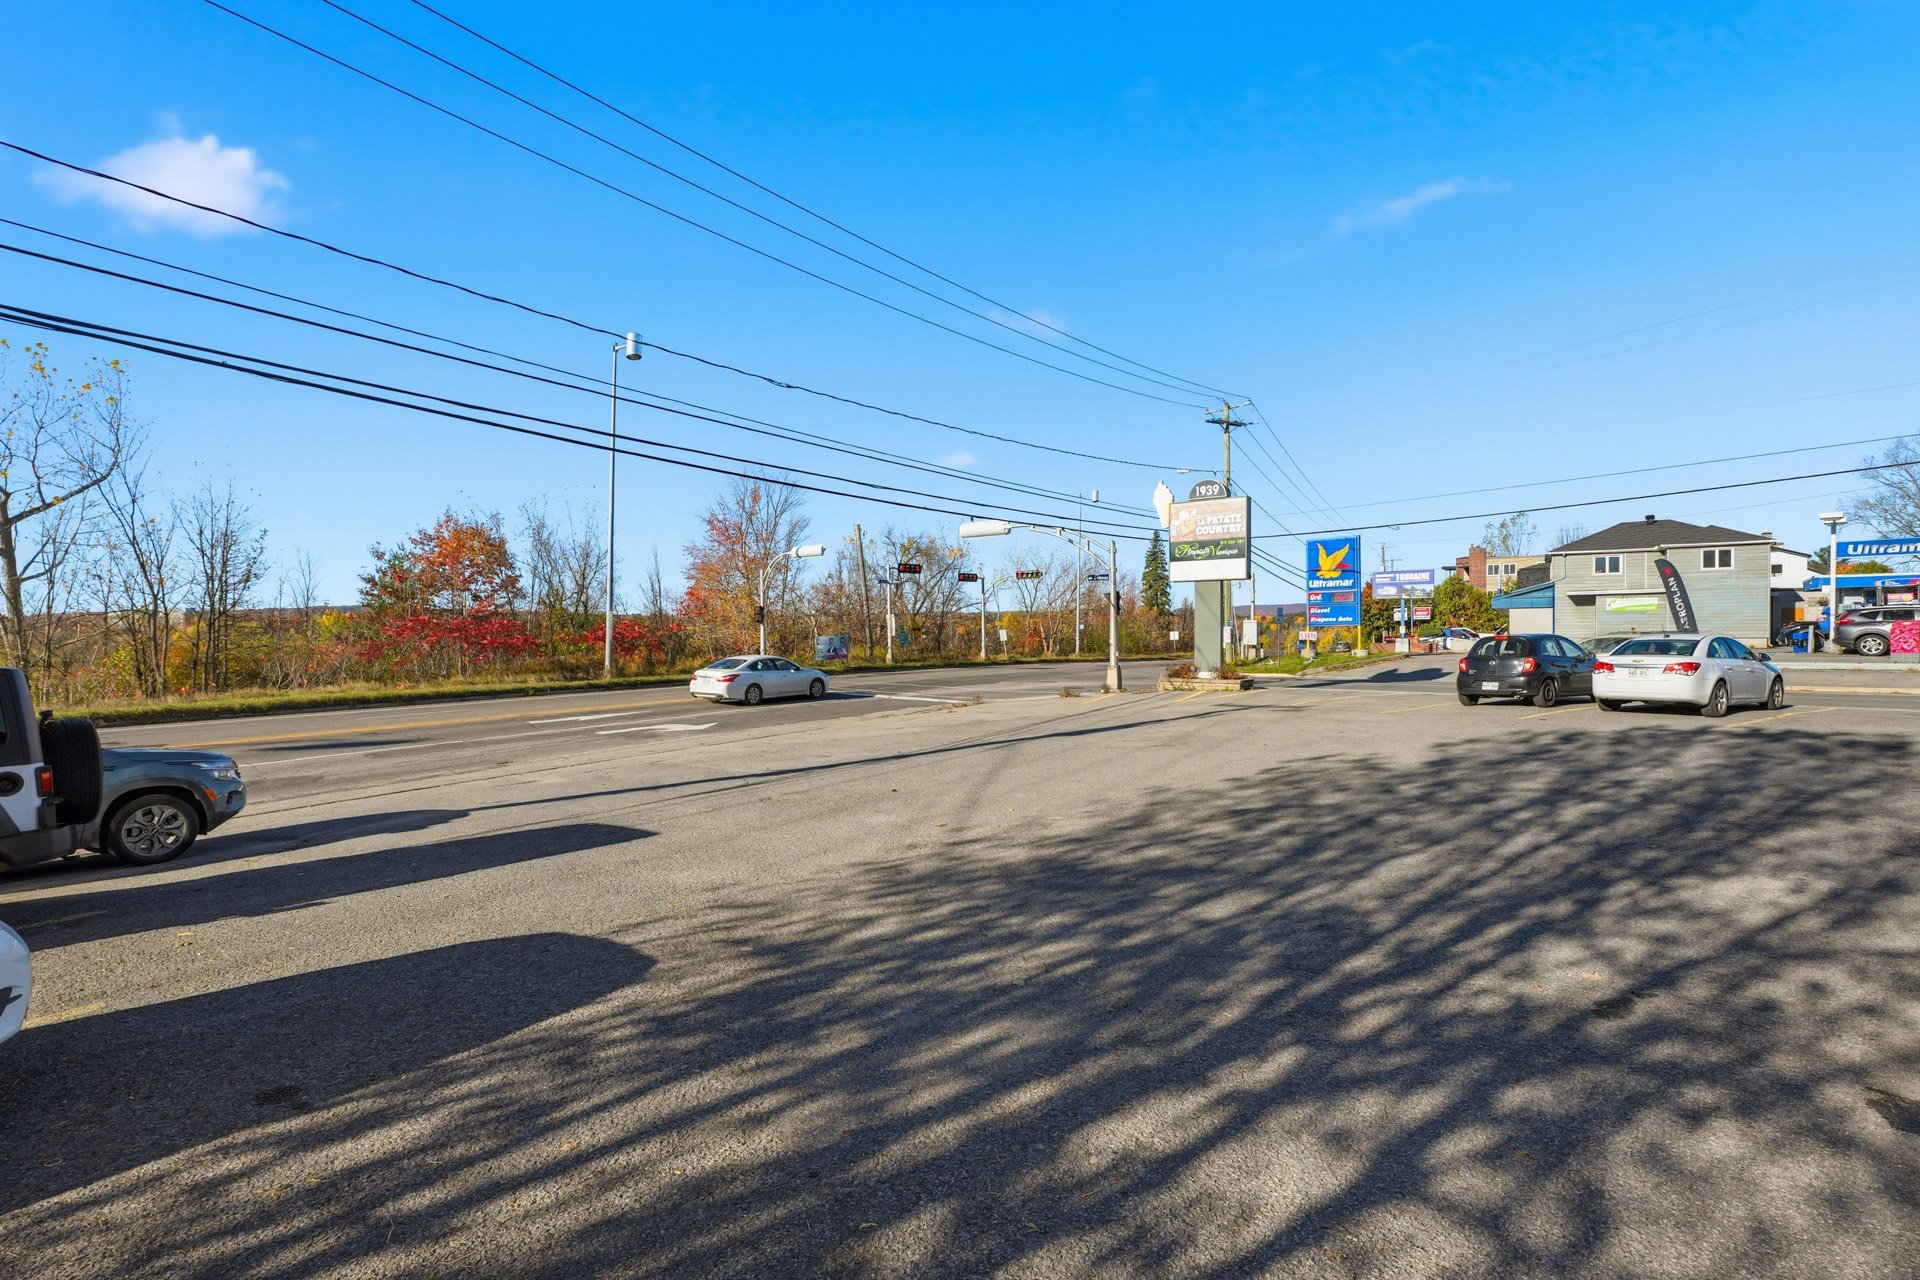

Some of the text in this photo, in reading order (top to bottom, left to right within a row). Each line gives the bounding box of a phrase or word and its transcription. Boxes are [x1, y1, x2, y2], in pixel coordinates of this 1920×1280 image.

[1195, 484, 1219, 496] 1939
[1206, 514, 1241, 525] PATATE
[1196, 523, 1243, 535] COUNTRY
[1395, 572, 1431, 581] TOURAINE
[1309, 580, 1354, 588] Ultramar
[1667, 576, 1690, 630] AEROPLAN
